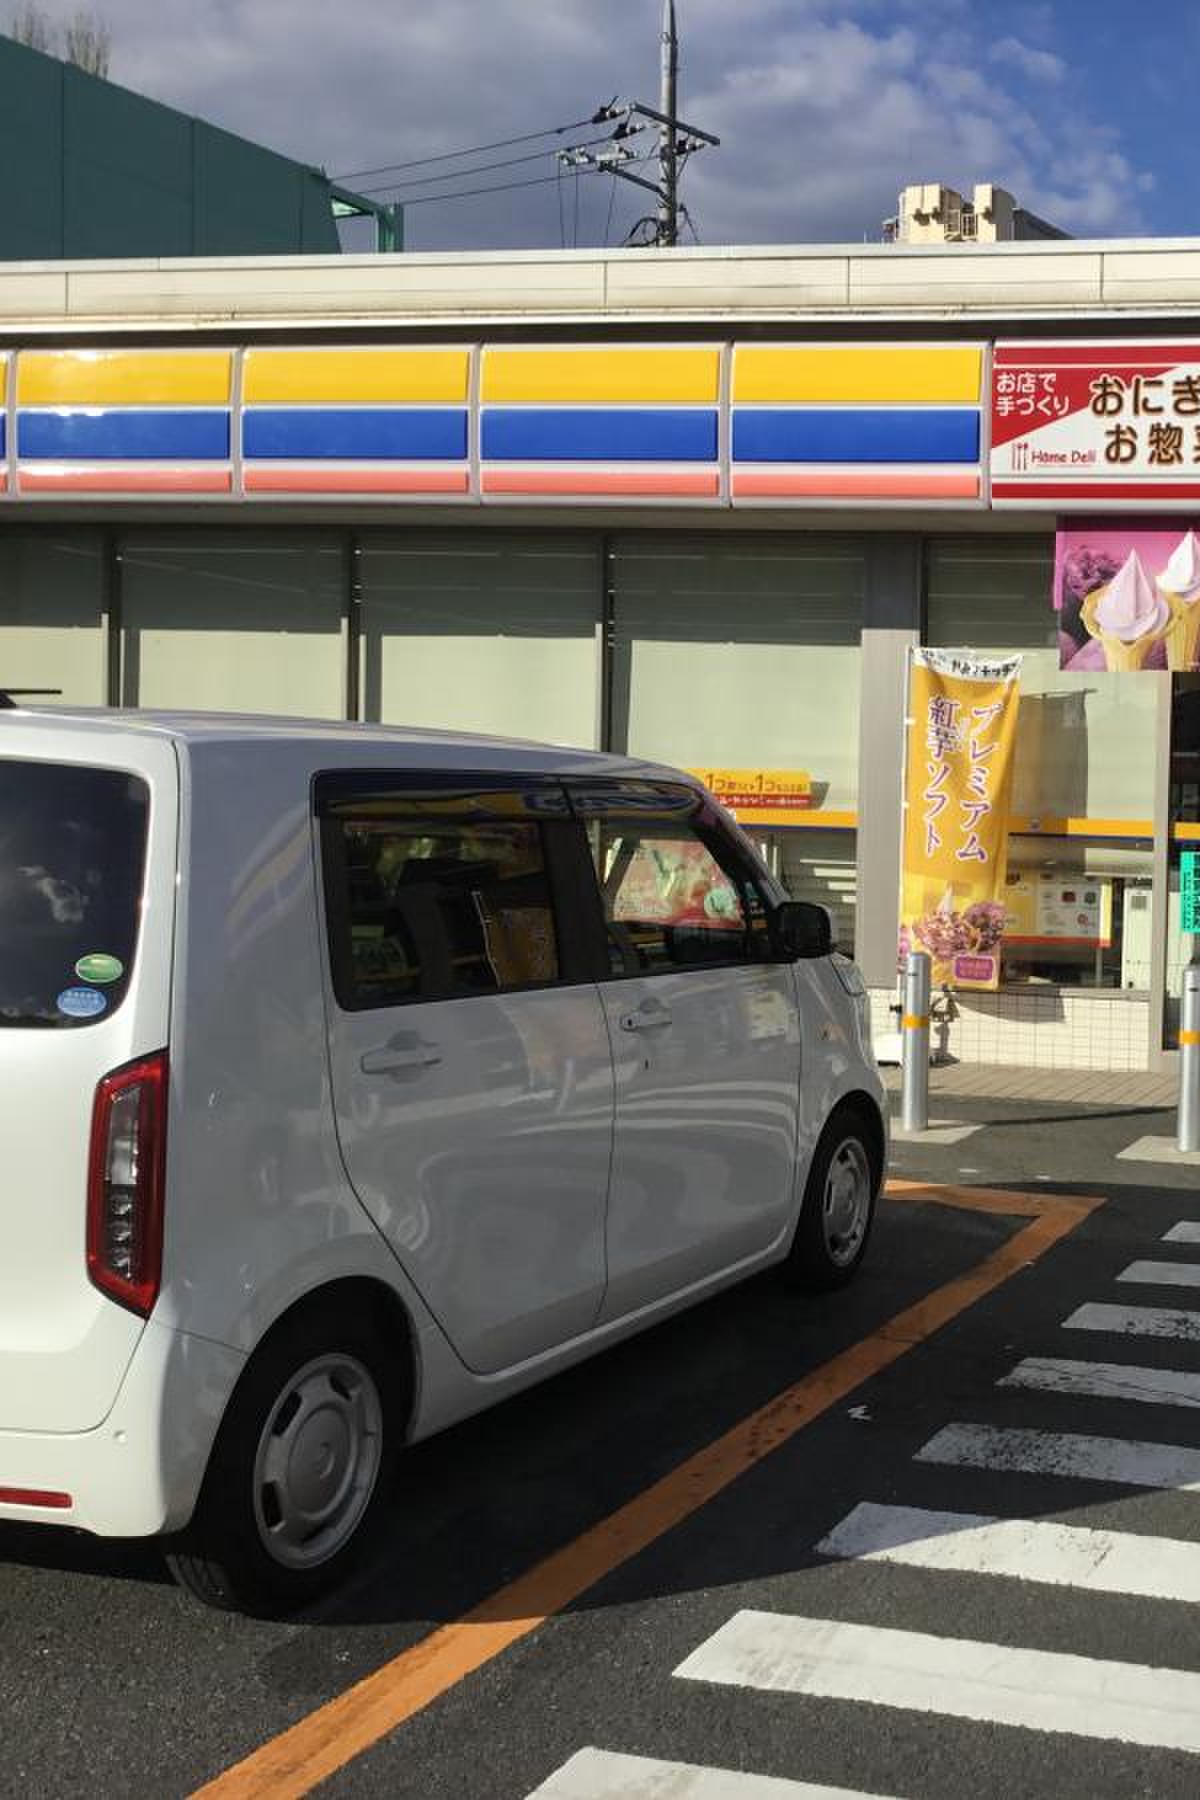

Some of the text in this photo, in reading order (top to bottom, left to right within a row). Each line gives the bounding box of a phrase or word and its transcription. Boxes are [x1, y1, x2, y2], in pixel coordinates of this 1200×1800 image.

[996, 371, 1056, 393] お店で
[995, 395, 1070, 417] 手づくり
[1071, 449, 1097, 464] Deli
[923, 695, 961, 858] 紅芋ソフト
[956, 703, 1003, 861] プレミアム
